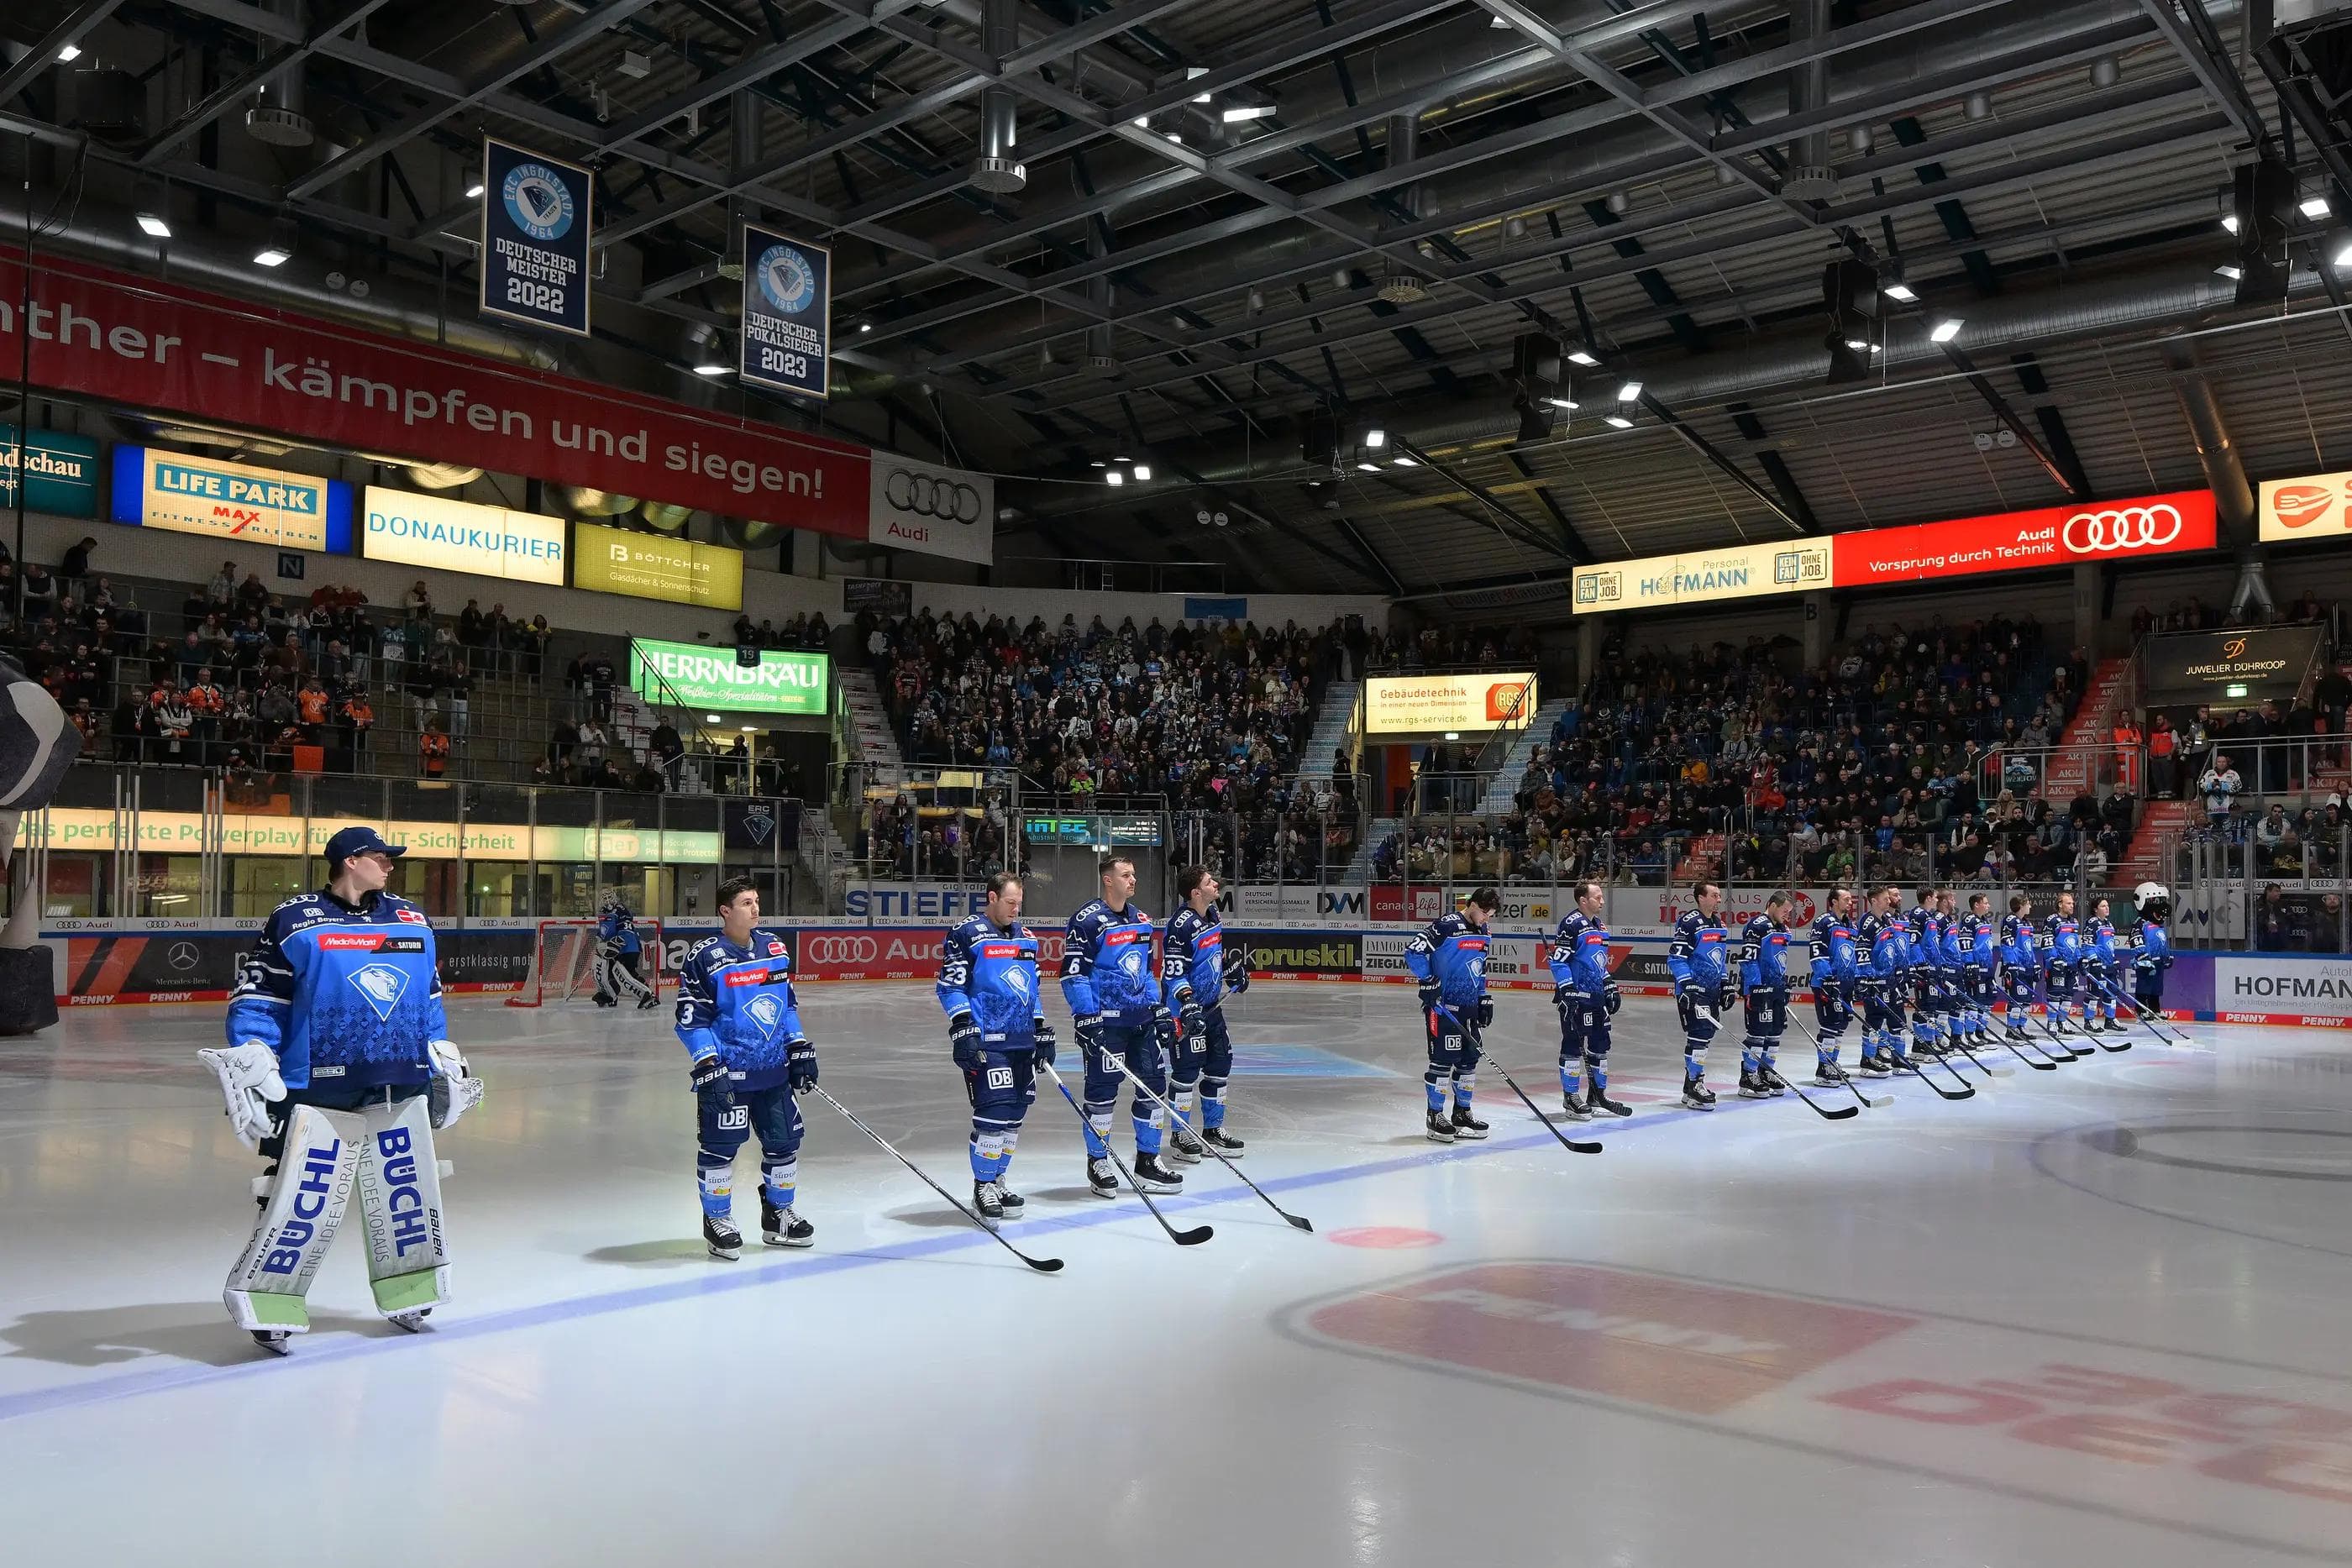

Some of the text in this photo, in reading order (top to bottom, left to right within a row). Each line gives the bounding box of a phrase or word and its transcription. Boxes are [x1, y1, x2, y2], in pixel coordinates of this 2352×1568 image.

[504, 165, 573, 220] ERC INGOLSTADT
[524, 222, 554, 239] 1964
[496, 238, 577, 275] DEUTSCHER
[507, 256, 567, 287] MEISTER
[507, 277, 564, 315] 2022
[752, 312, 818, 343] DEUTSCHER
[747, 324, 822, 358] POKALSIEGER
[761, 347, 807, 380] 2023
[264, 347, 533, 441] kämpfen
[552, 419, 648, 463] und
[665, 441, 823, 500] siegen!
[164, 469, 308, 511] LIFE PARK
[152, 511, 230, 528] FITNESS
[213, 506, 260, 534] MAX
[370, 513, 561, 560] DONAUKURIER
[887, 521, 930, 543] Audi
[2017, 526, 2055, 543] Audi
[635, 552, 710, 572] BÖTTCHER
[1703, 556, 1749, 569] Personal
[1778, 553, 1822, 567] KEIN OHNE
[1869, 542, 2055, 573] Vorsprung durch Technik
[282, 557, 301, 577] N
[1779, 564, 1823, 579] FAN JOB.
[610, 571, 710, 595] Glasdächer & Sonnenschutz
[1580, 575, 1617, 589] KEIN OHNE
[1640, 568, 1749, 597] HOFMANN
[1580, 586, 1619, 600] FAN JOB.
[1806, 604, 1817, 619] B
[2186, 660, 2286, 674] JUWELIER DÜHRKOOP
[1380, 688, 1467, 699] Gebäudetechnik
[1499, 691, 1520, 707] RGS
[1380, 715, 1467, 726] www.rgs-service.de
[64, 820, 172, 842] perfekte
[307, 827, 333, 844] fü
[392, 831, 515, 849] IT-Sicherheit
[846, 890, 991, 917] STIEFE
[1317, 893, 1364, 914] DVM
[1416, 893, 1440, 910] life
[1659, 894, 1761, 904] BACAUS
[292, 918, 316, 930] Regio
[1961, 940, 1971, 949] 11
[2044, 937, 2054, 947] 25
[2134, 937, 2144, 946] 64
[1222, 942, 1362, 970] uckpruskil.
[1553, 949, 1571, 962] 67
[1745, 947, 1757, 960] 21
[1813, 945, 1820, 956] 5
[1857, 952, 1870, 962] 22
[449, 953, 509, 969] erstklassig
[1068, 957, 1080, 975] 6
[1166, 960, 1184, 976] 33
[1644, 962, 1674, 975] SATUR
[155, 978, 212, 987] Mercedes-Benz
[795, 973, 821, 982] PENNY.
[944, 967, 967, 985] 23
[482, 983, 516, 992] PENNY.
[71, 994, 116, 1006] PENNY.
[149, 992, 193, 1003] PENNY.
[680, 1003, 694, 1025] 3
[2225, 1013, 2268, 1024] PENNY.
[2302, 1016, 2346, 1027] PENNY.
[1193, 1038, 1206, 1051] DB
[1447, 1036, 1462, 1048] DB
[991, 1071, 1012, 1087] DB
[722, 1109, 747, 1126] DB
[361, 1171, 377, 1206] IDEE
[376, 1126, 428, 1258] BÜCHL
[261, 1138, 340, 1275] BÜCHL
[299, 1141, 360, 1278] EINE IDEE VORAUS
[368, 1207, 390, 1263] VORAUS
